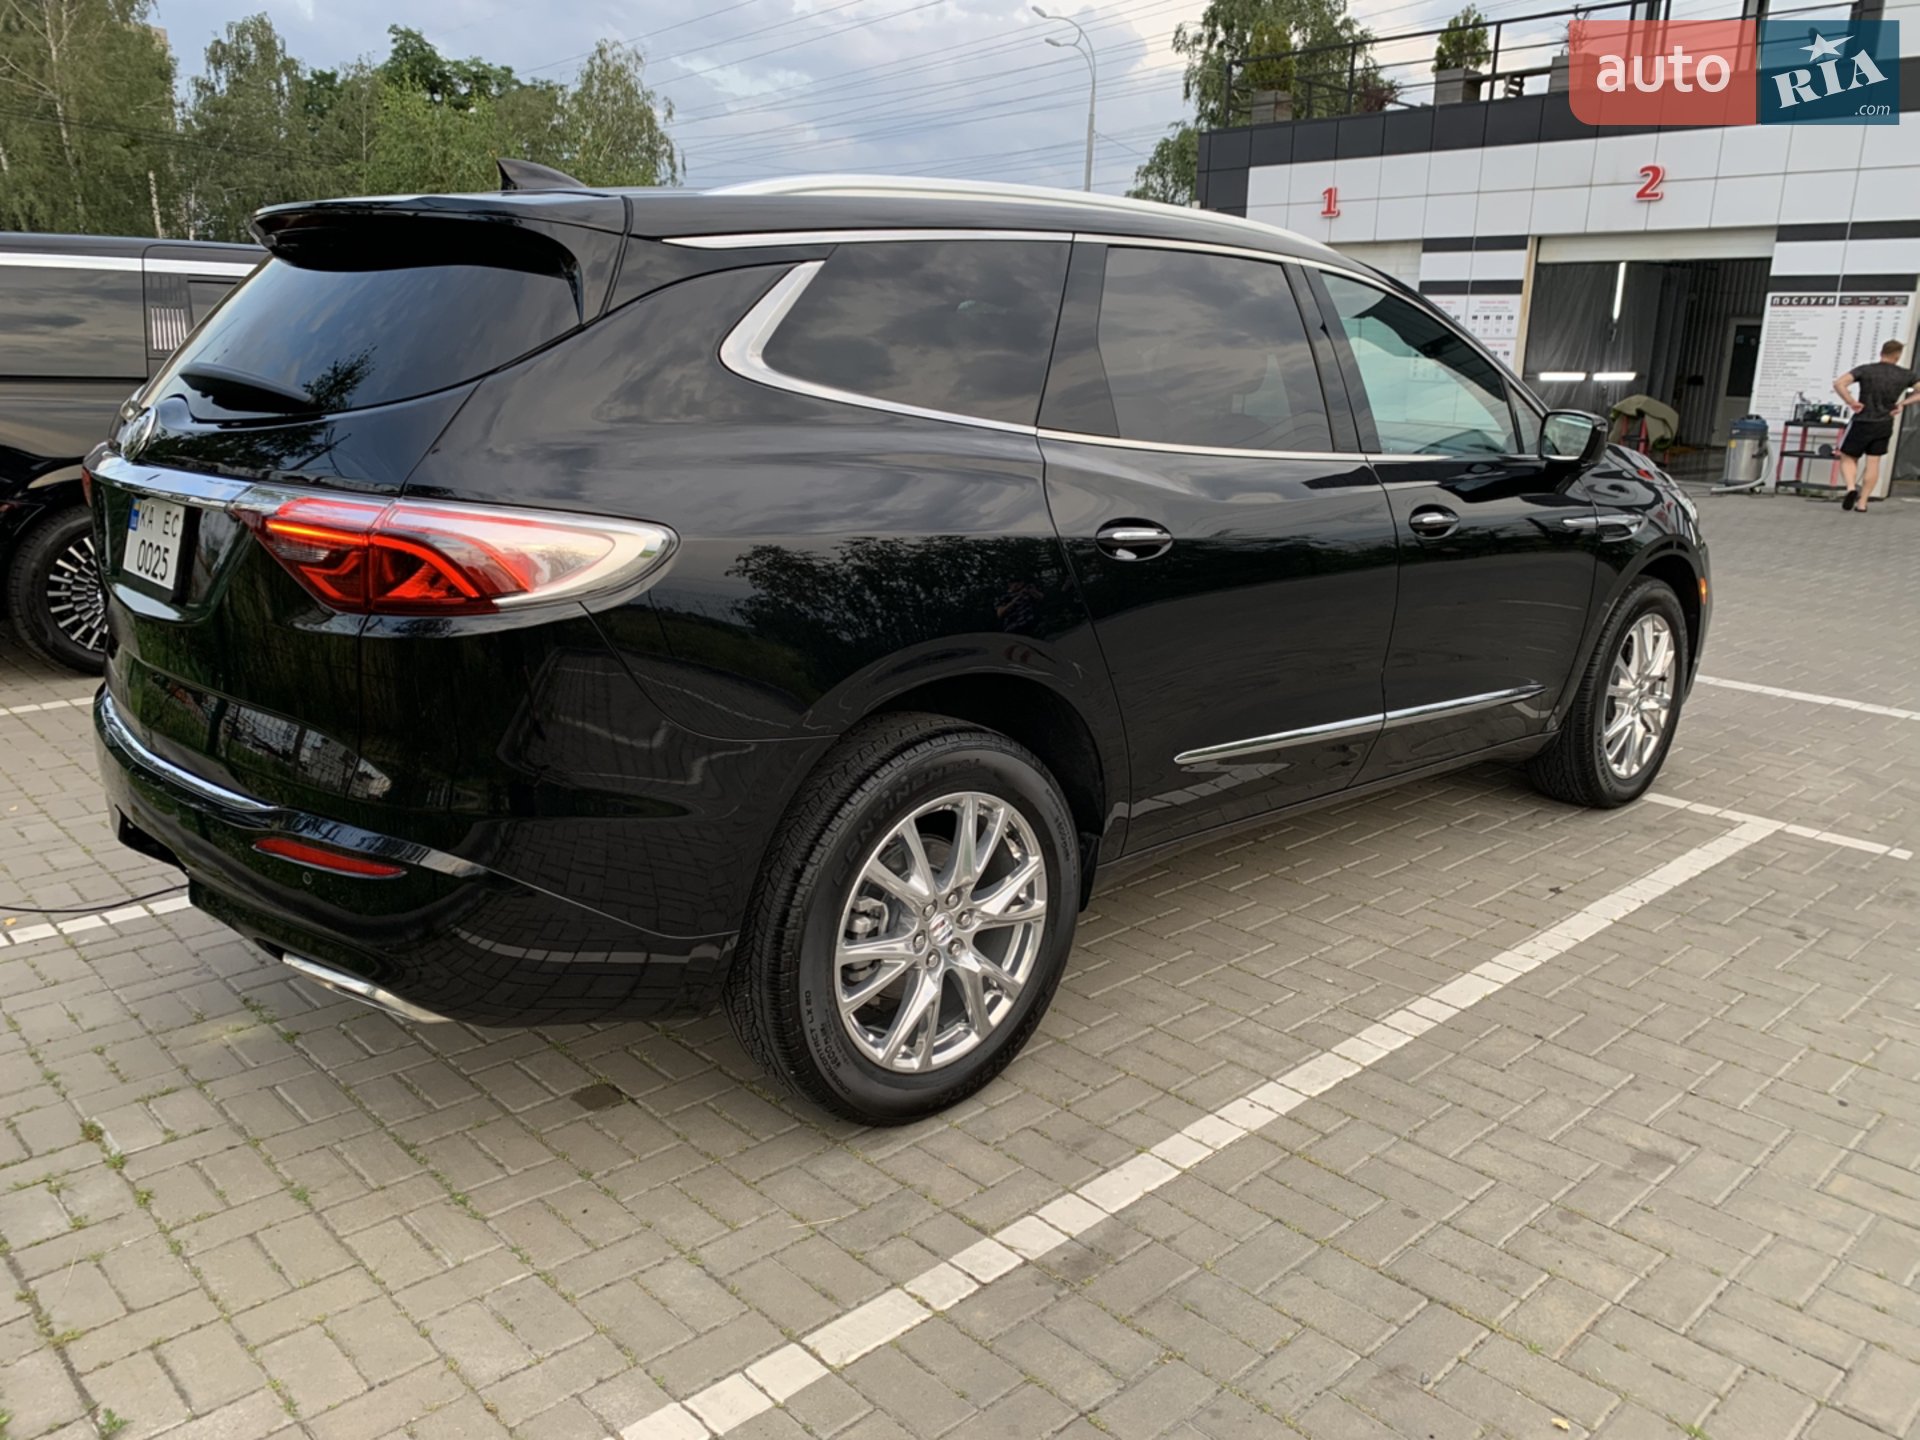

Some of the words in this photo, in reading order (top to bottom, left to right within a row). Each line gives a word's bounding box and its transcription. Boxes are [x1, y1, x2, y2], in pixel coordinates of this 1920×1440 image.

[1636, 165, 1664, 201] 2
[1321, 187, 1340, 217] 1
[1772, 296, 1835, 306] ПОСЛУГИ
[136, 539, 169, 581] 0025
